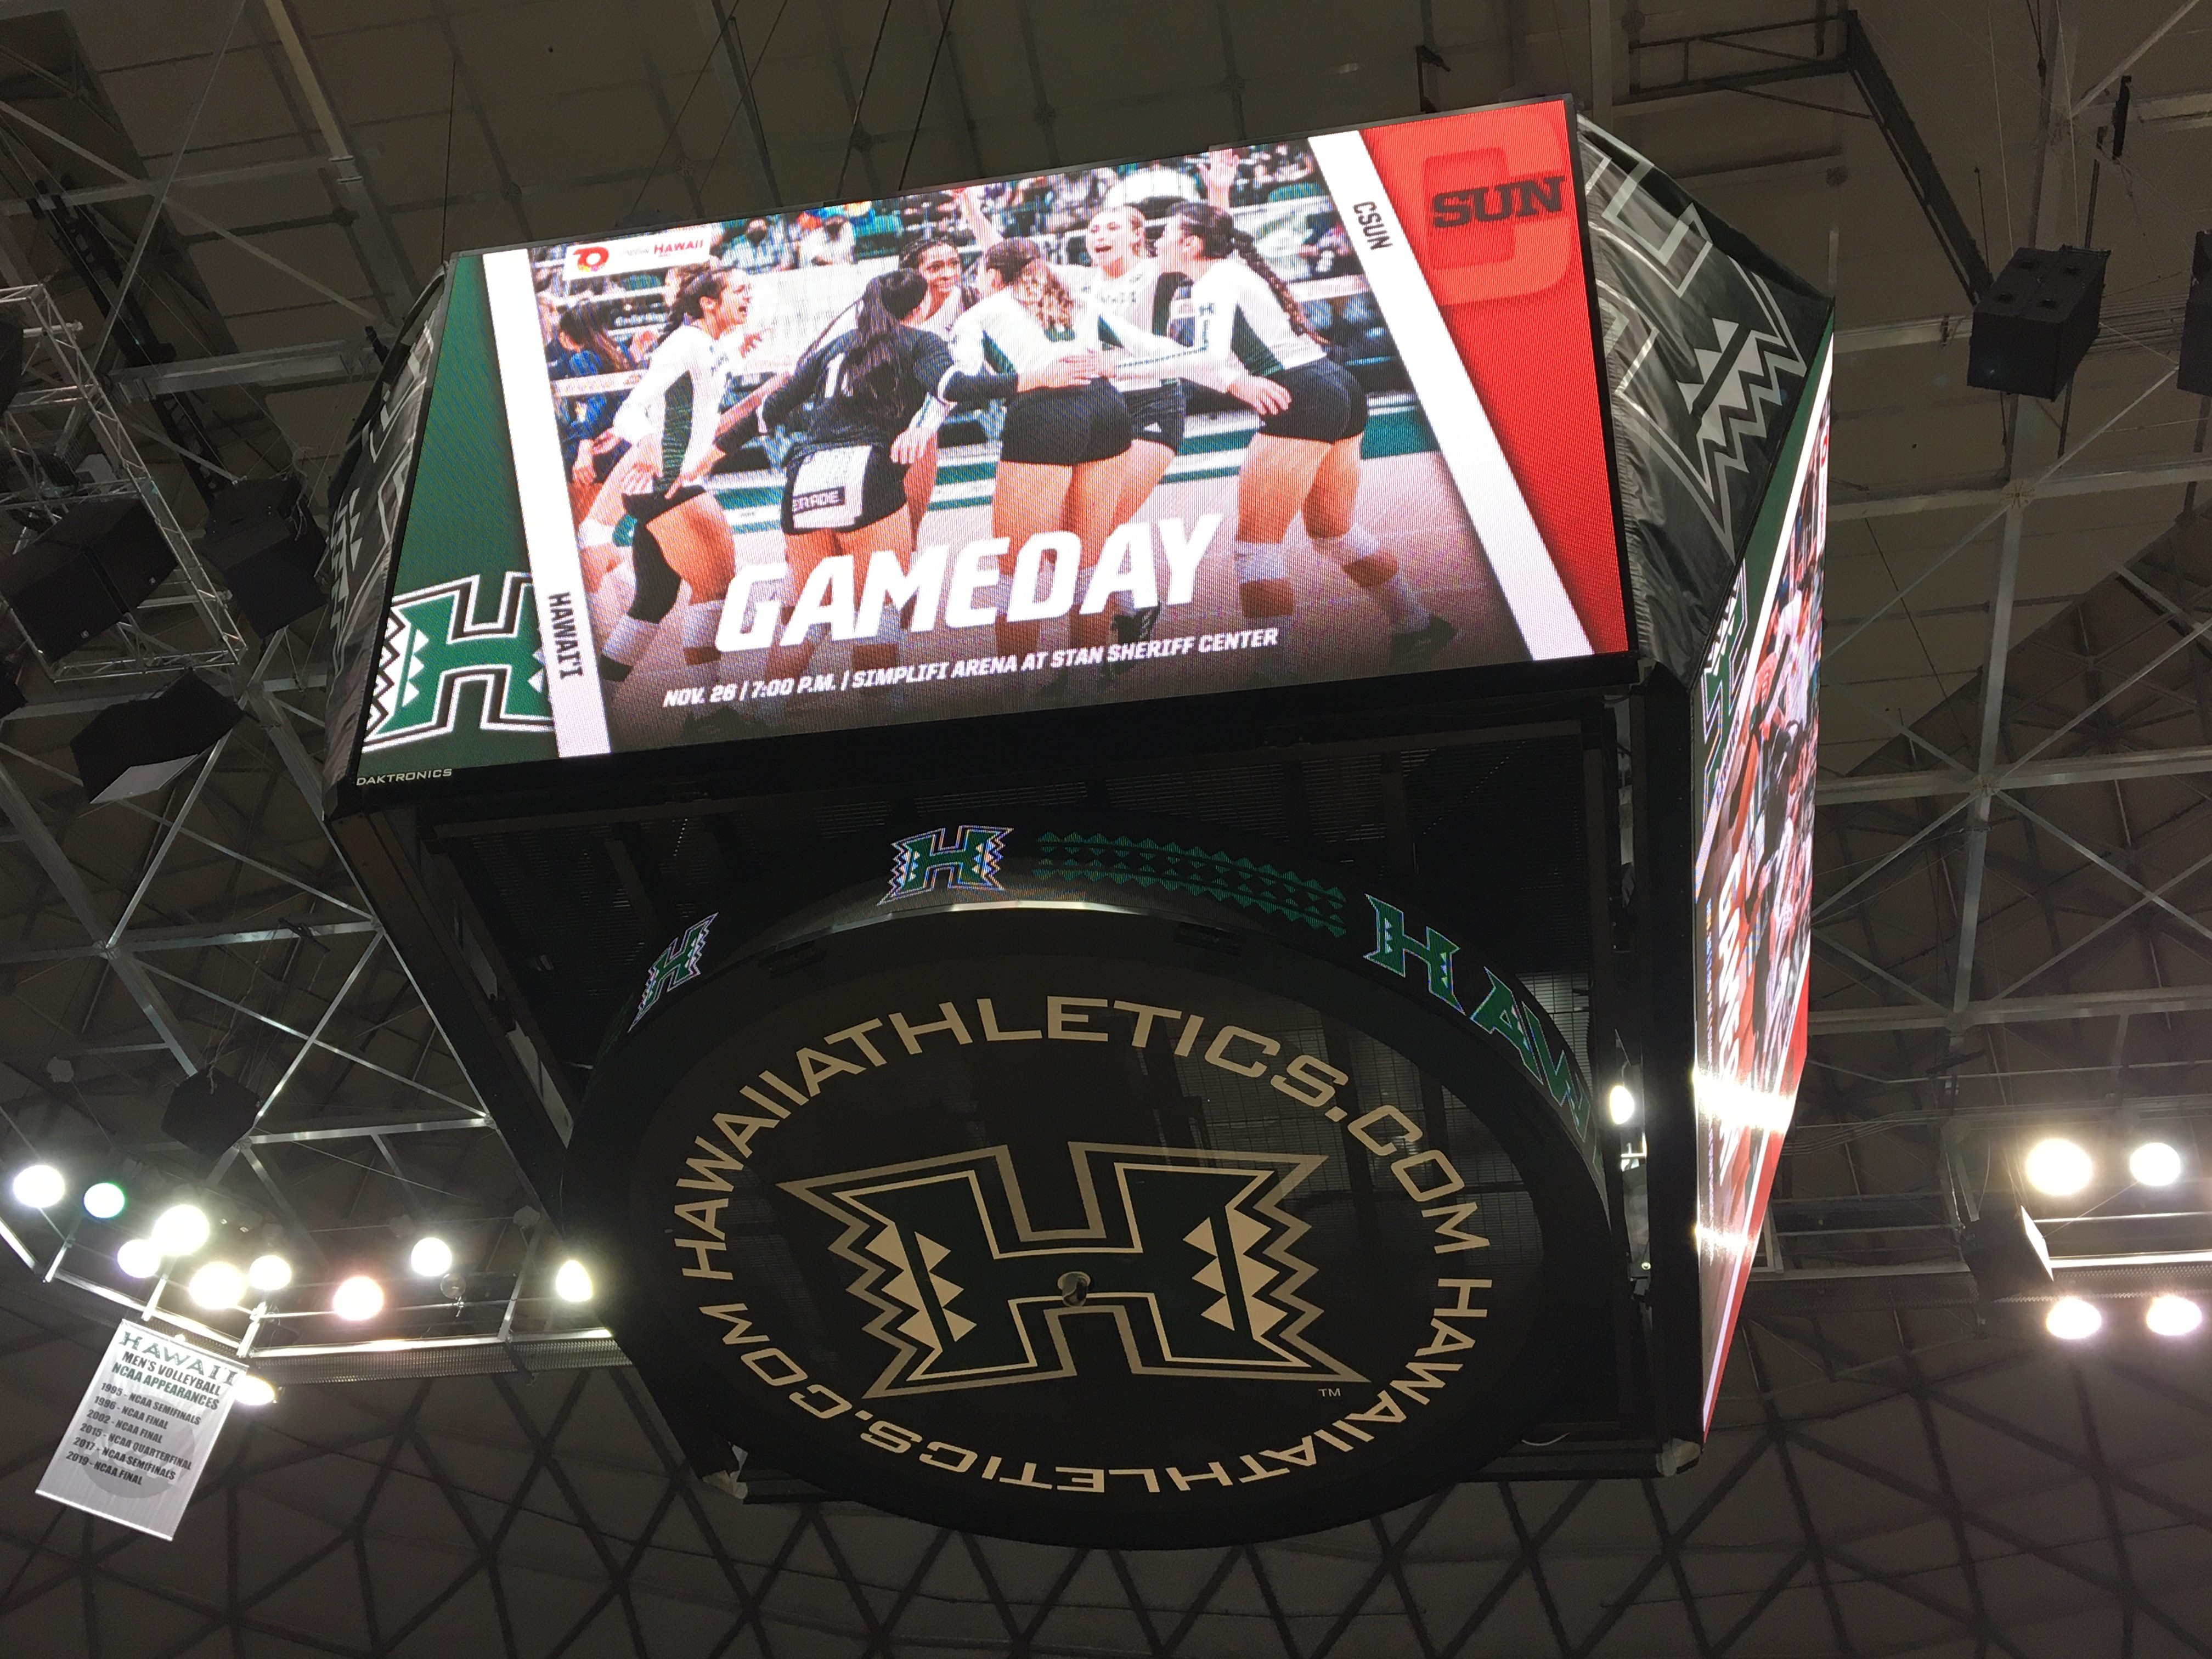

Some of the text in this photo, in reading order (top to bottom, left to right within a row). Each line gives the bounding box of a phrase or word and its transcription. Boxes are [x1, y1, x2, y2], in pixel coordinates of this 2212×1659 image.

[1353, 201, 1393, 250] CSUN
[1432, 175, 1565, 229] SUN
[714, 512, 1223, 653] GAMEDAY
[549, 591, 583, 679] HAWAI'I
[663, 689, 705, 708] NOV.
[751, 678, 794, 699] 7:00
[797, 673, 836, 693] P.M.
[851, 661, 950, 689] SIMPLIFI
[951, 654, 1018, 678] ARENA
[1020, 651, 1049, 671] AT
[1050, 646, 1105, 668] STAN
[1107, 636, 1195, 662] SHERIFF
[1198, 627, 1278, 653] CENTER
[356, 769, 453, 786] DAKTRONICS
[674, 996, 1491, 1281] HAWAIIATHLETICS.COM
[111, 1362, 220, 1410] NCAA APPEARANCES
[122, 1351, 221, 1396] MEN'S VOLLEYBALL
[700, 1278, 1493, 1493] HAWAIIATHLETICS.COM
[1318, 1388, 1341, 1397] TM
[87, 1409, 111, 1424] 2002
[115, 1419, 141, 1435] NCAA
[139, 1428, 163, 1444] FINAL
[94, 1396, 117, 1410] 1996
[121, 1406, 145, 1421] NCAA
[145, 1414, 169, 1430] FINAL
[101, 1383, 123, 1396] 1995
[128, 1392, 153, 1408] NCAA
[153, 1401, 201, 1426] SEMIFINALS
[65, 1451, 89, 1466] 2019
[94, 1460, 119, 1477] NCAA
[118, 1470, 143, 1486] FINAL
[73, 1437, 95, 1451] 2017
[102, 1447, 126, 1462] NCAA
[126, 1455, 176, 1481] SEMIFINALS
[80, 1423, 103, 1437] 2015
[108, 1433, 132, 1448] NCAA
[132, 1443, 193, 1470] QUARTERFINAL
